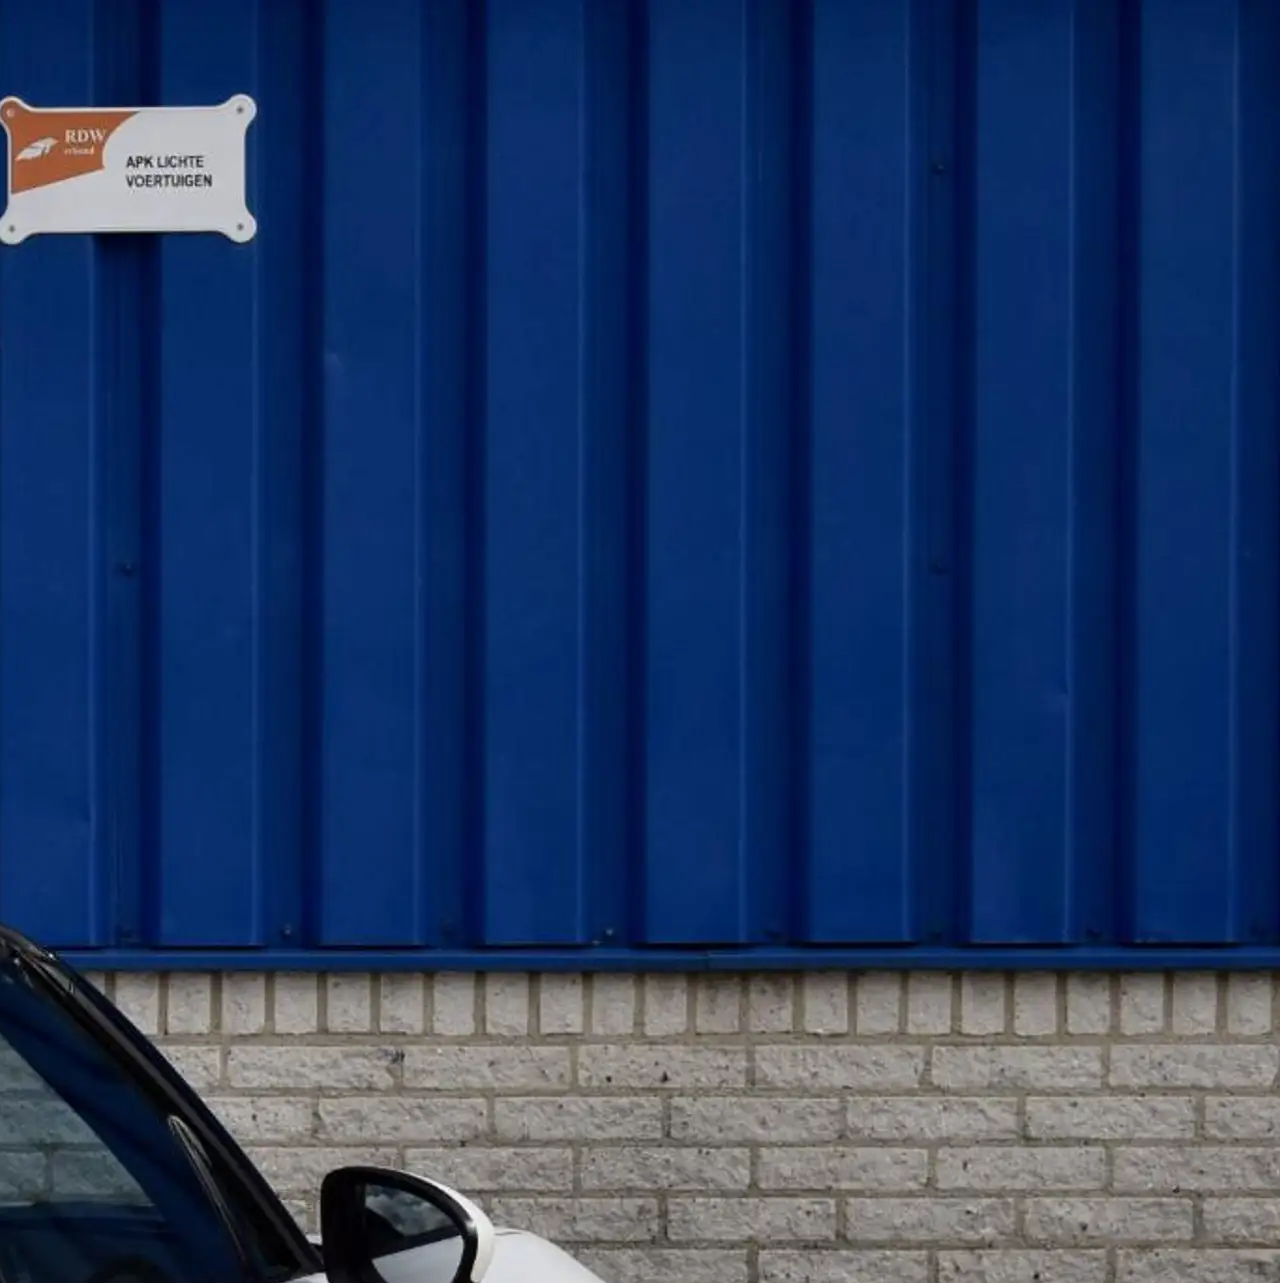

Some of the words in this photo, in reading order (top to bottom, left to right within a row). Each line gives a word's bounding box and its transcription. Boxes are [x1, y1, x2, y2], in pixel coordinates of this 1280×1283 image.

[65, 129, 107, 144] RDW
[126, 156, 153, 169] APK
[157, 156, 204, 169] LICHTE
[126, 175, 213, 188] VOERTUIGEN
